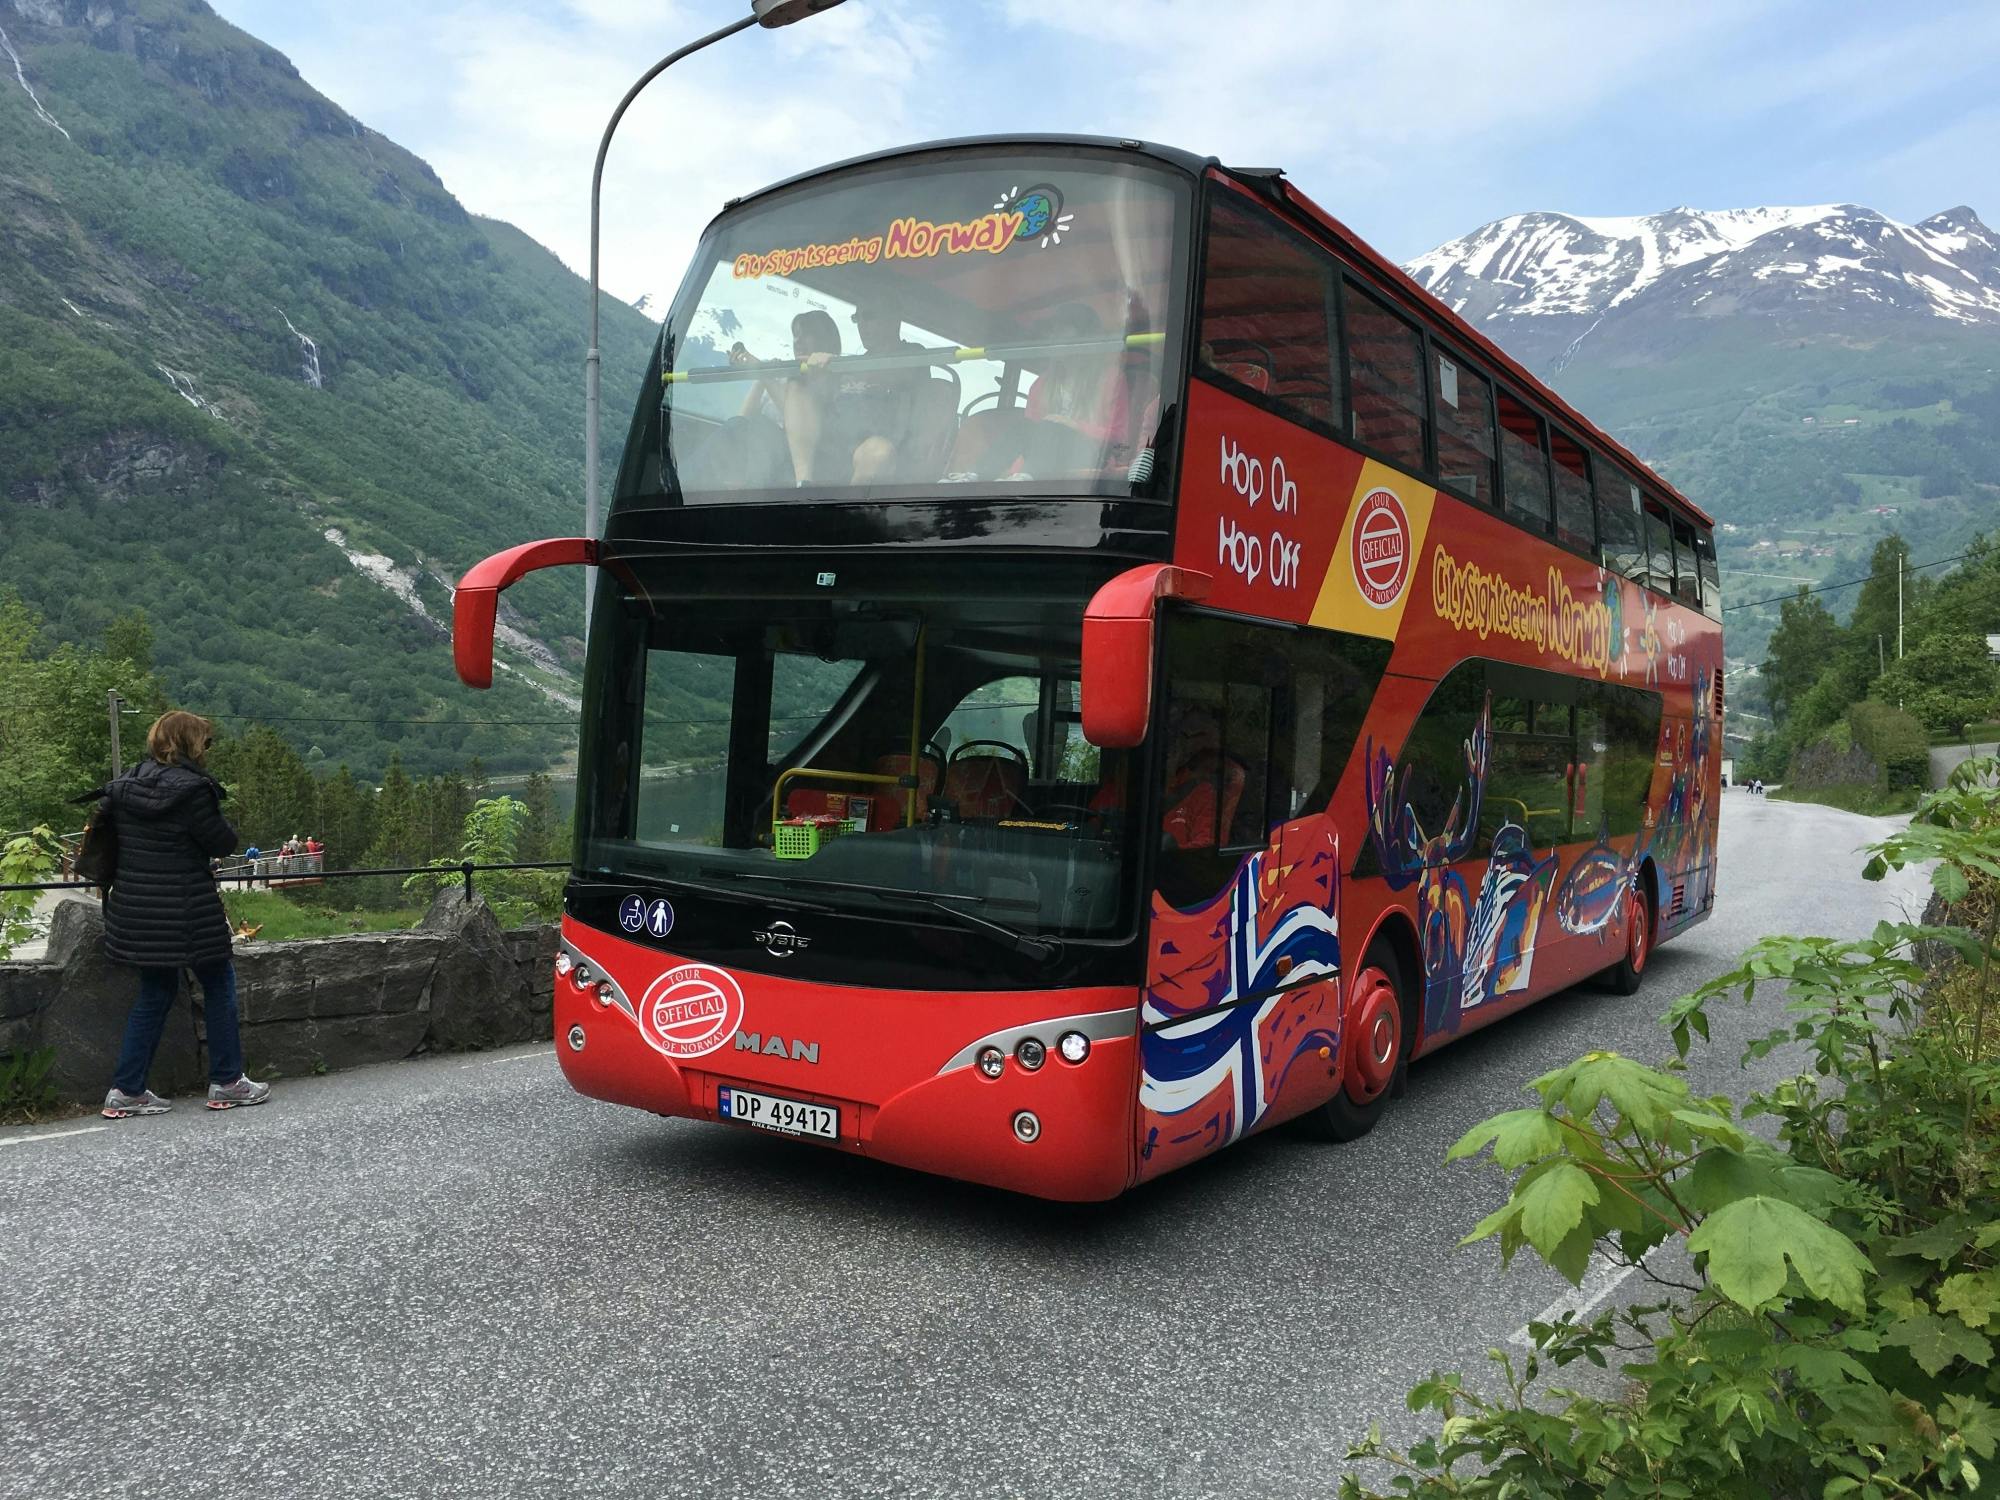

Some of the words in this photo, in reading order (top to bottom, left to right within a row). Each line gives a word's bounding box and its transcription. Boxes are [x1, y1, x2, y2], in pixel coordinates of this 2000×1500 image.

[885, 212, 1024, 259] Norway
[1220, 435, 1264, 507] Hop
[1271, 456, 1297, 515] On
[1370, 494, 1390, 509] TOUR
[1218, 516, 1263, 585] Hop
[1269, 531, 1301, 589] Off
[1362, 535, 1402, 561] OFFICIAL
[1364, 583, 1374, 599] OF
[1375, 576, 1402, 603] NORWAY
[1548, 565, 1613, 680] Norway
[668, 969, 701, 985] TOUR
[657, 997, 724, 1025] OFFICIAL
[662, 1040, 676, 1052] OF
[680, 1028, 725, 1054] NORWAY
[734, 1031, 820, 1064] MAN
[722, 1105, 729, 1113] N
[736, 1094, 761, 1119] DP
[770, 1102, 831, 1135] 49412
